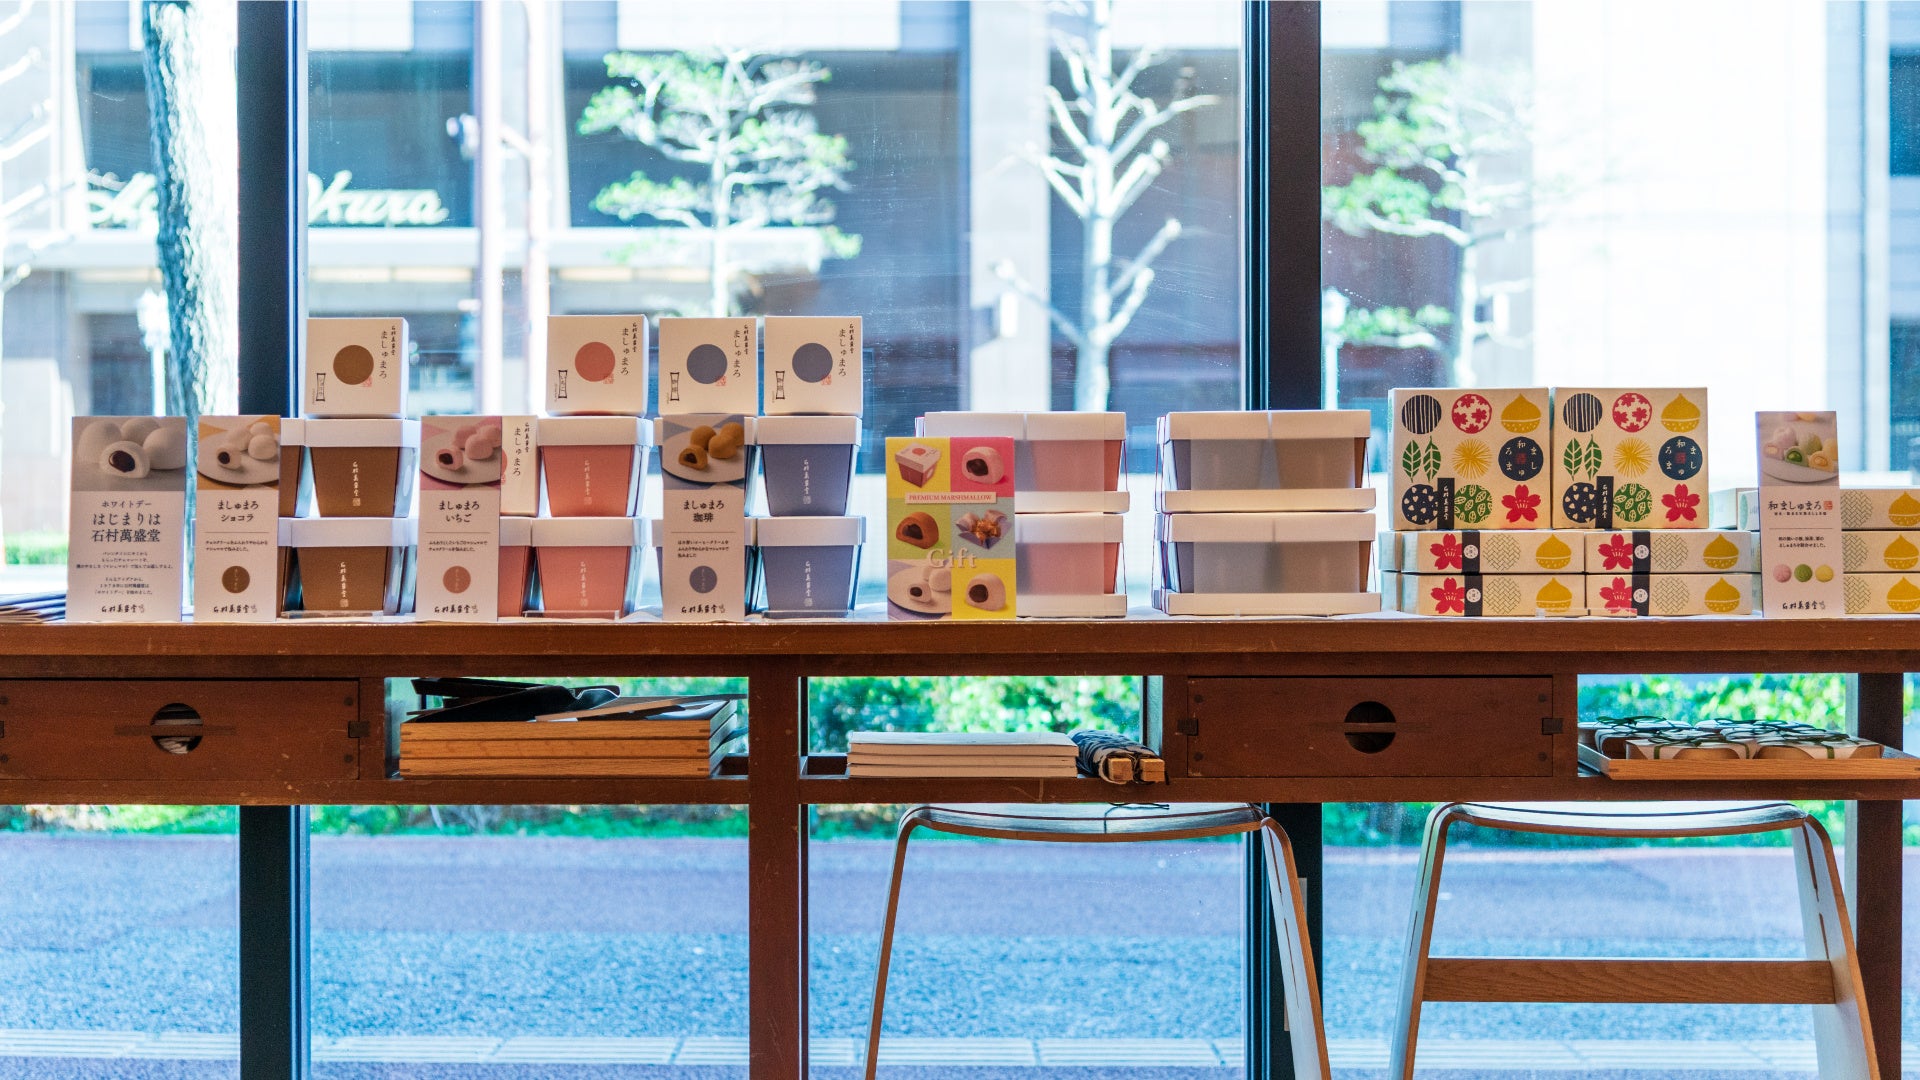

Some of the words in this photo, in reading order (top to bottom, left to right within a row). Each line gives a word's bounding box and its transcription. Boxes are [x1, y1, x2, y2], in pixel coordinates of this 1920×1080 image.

[378, 330, 389, 379] ましゅまろ
[620, 327, 630, 376] ましゅまろ
[732, 329, 742, 378] ましゅまろ
[838, 328, 847, 377] ましゅまろ
[512, 426, 522, 477] ましゅまろ
[101, 499, 152, 509] ホワイトデー
[217, 499, 259, 511] ましゅまろ
[438, 500, 480, 511] ましゅまろ
[683, 499, 725, 511] ましゅまろ
[1767, 500, 1822, 511] 和ましゅまろ
[92, 511, 161, 526] はじまりは
[220, 513, 255, 523] ショコラ
[445, 513, 472, 523] いちご
[692, 512, 714, 523] 珈琲
[91, 528, 161, 543] 石村萬盛堂
[926, 548, 977, 569] Gift
